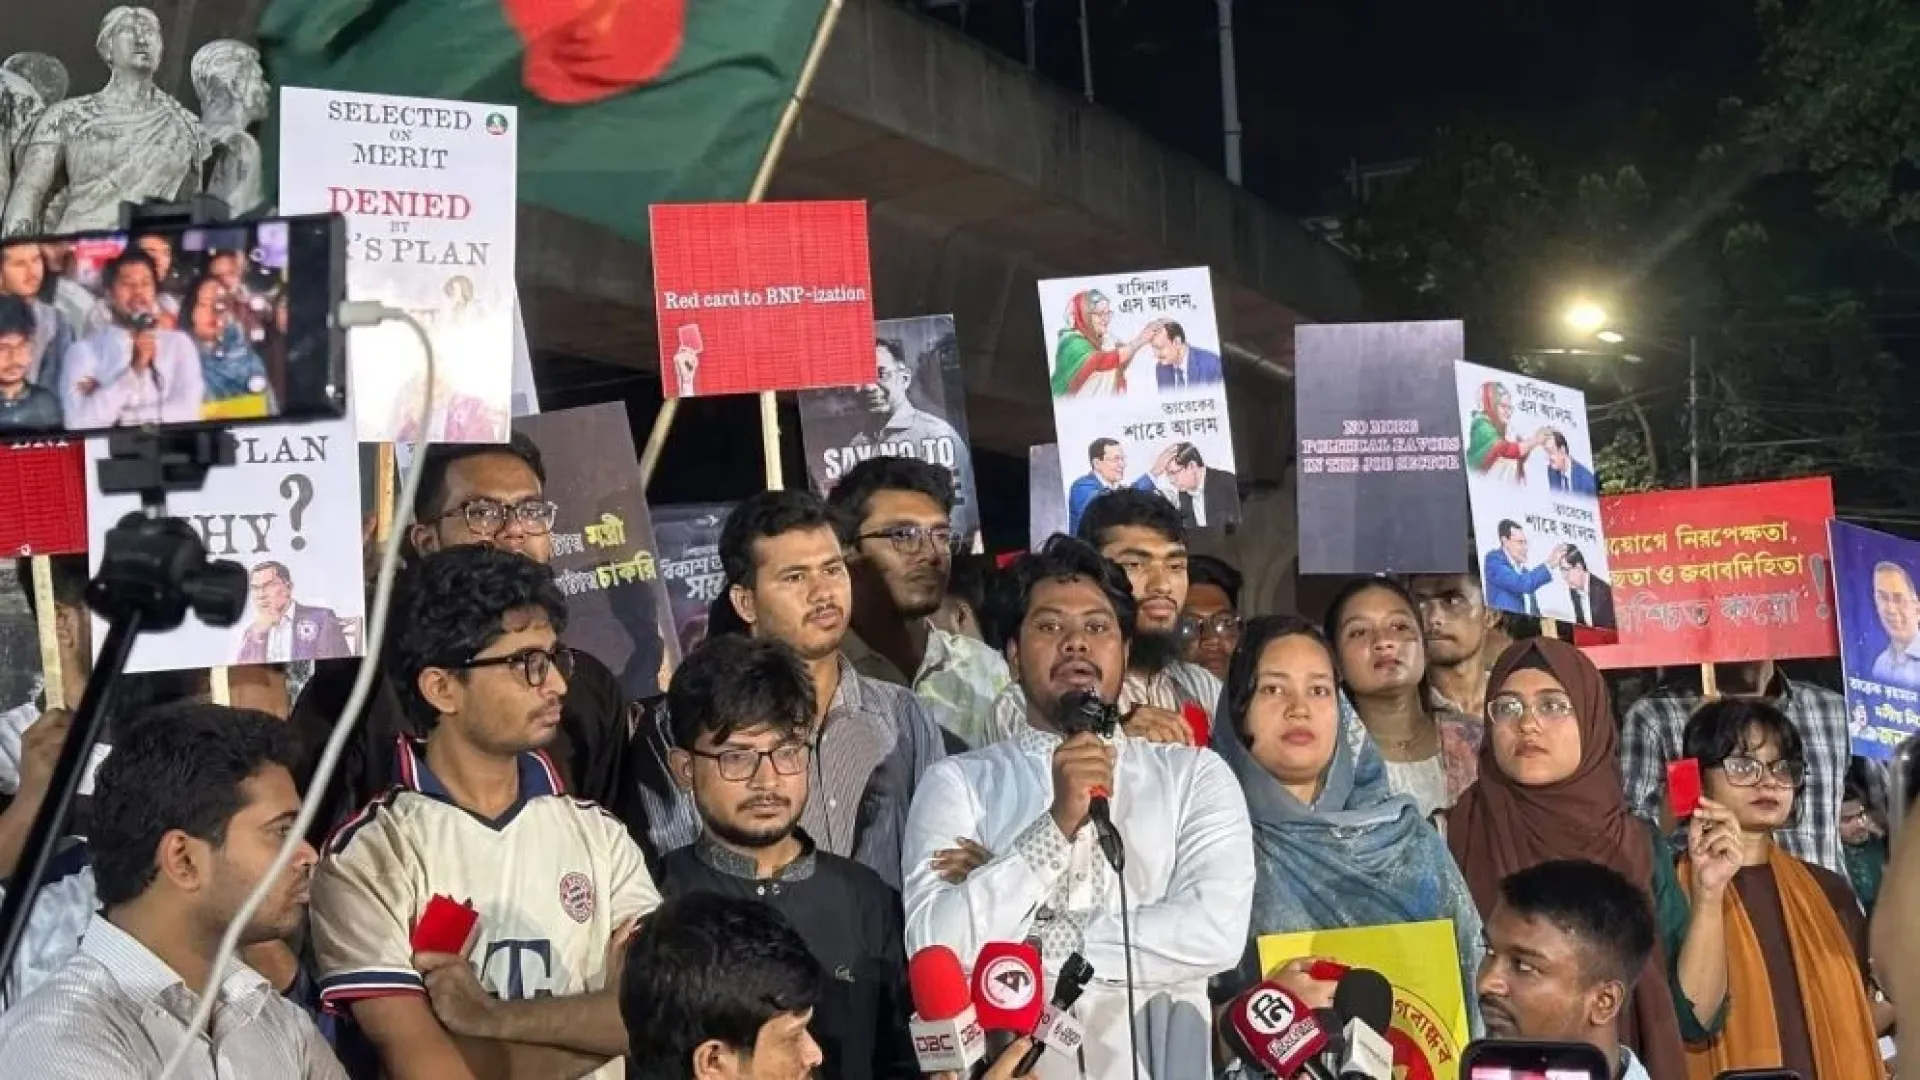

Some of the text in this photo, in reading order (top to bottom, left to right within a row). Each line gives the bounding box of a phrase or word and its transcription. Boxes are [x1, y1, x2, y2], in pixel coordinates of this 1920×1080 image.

[328, 100, 472, 130] SELECTED
[389, 128, 412, 142] ON
[352, 142, 449, 169] MERIT
[328, 186, 472, 220] DENIED
[346, 232, 490, 265] 'S PLAN
[664, 284, 866, 309] Red card to BNP-ization
[1117, 278, 1169, 295] হাসিনার
[1162, 399, 1215, 415] তারেকের
[1171, 418, 1218, 436] আলম
[1343, 420, 1419, 434] NO MORE
[235, 435, 329, 463] LAN
[922, 437, 954, 468] TO
[1302, 438, 1391, 454] POLITICAL
[1303, 455, 1460, 473] IN THE JOB SECTOR
[596, 550, 657, 589] চাকরি
[1656, 565, 1675, 586] ও
[1679, 550, 1804, 583] জবাবদিহিতা
[914, 1034, 954, 1052] DBC
